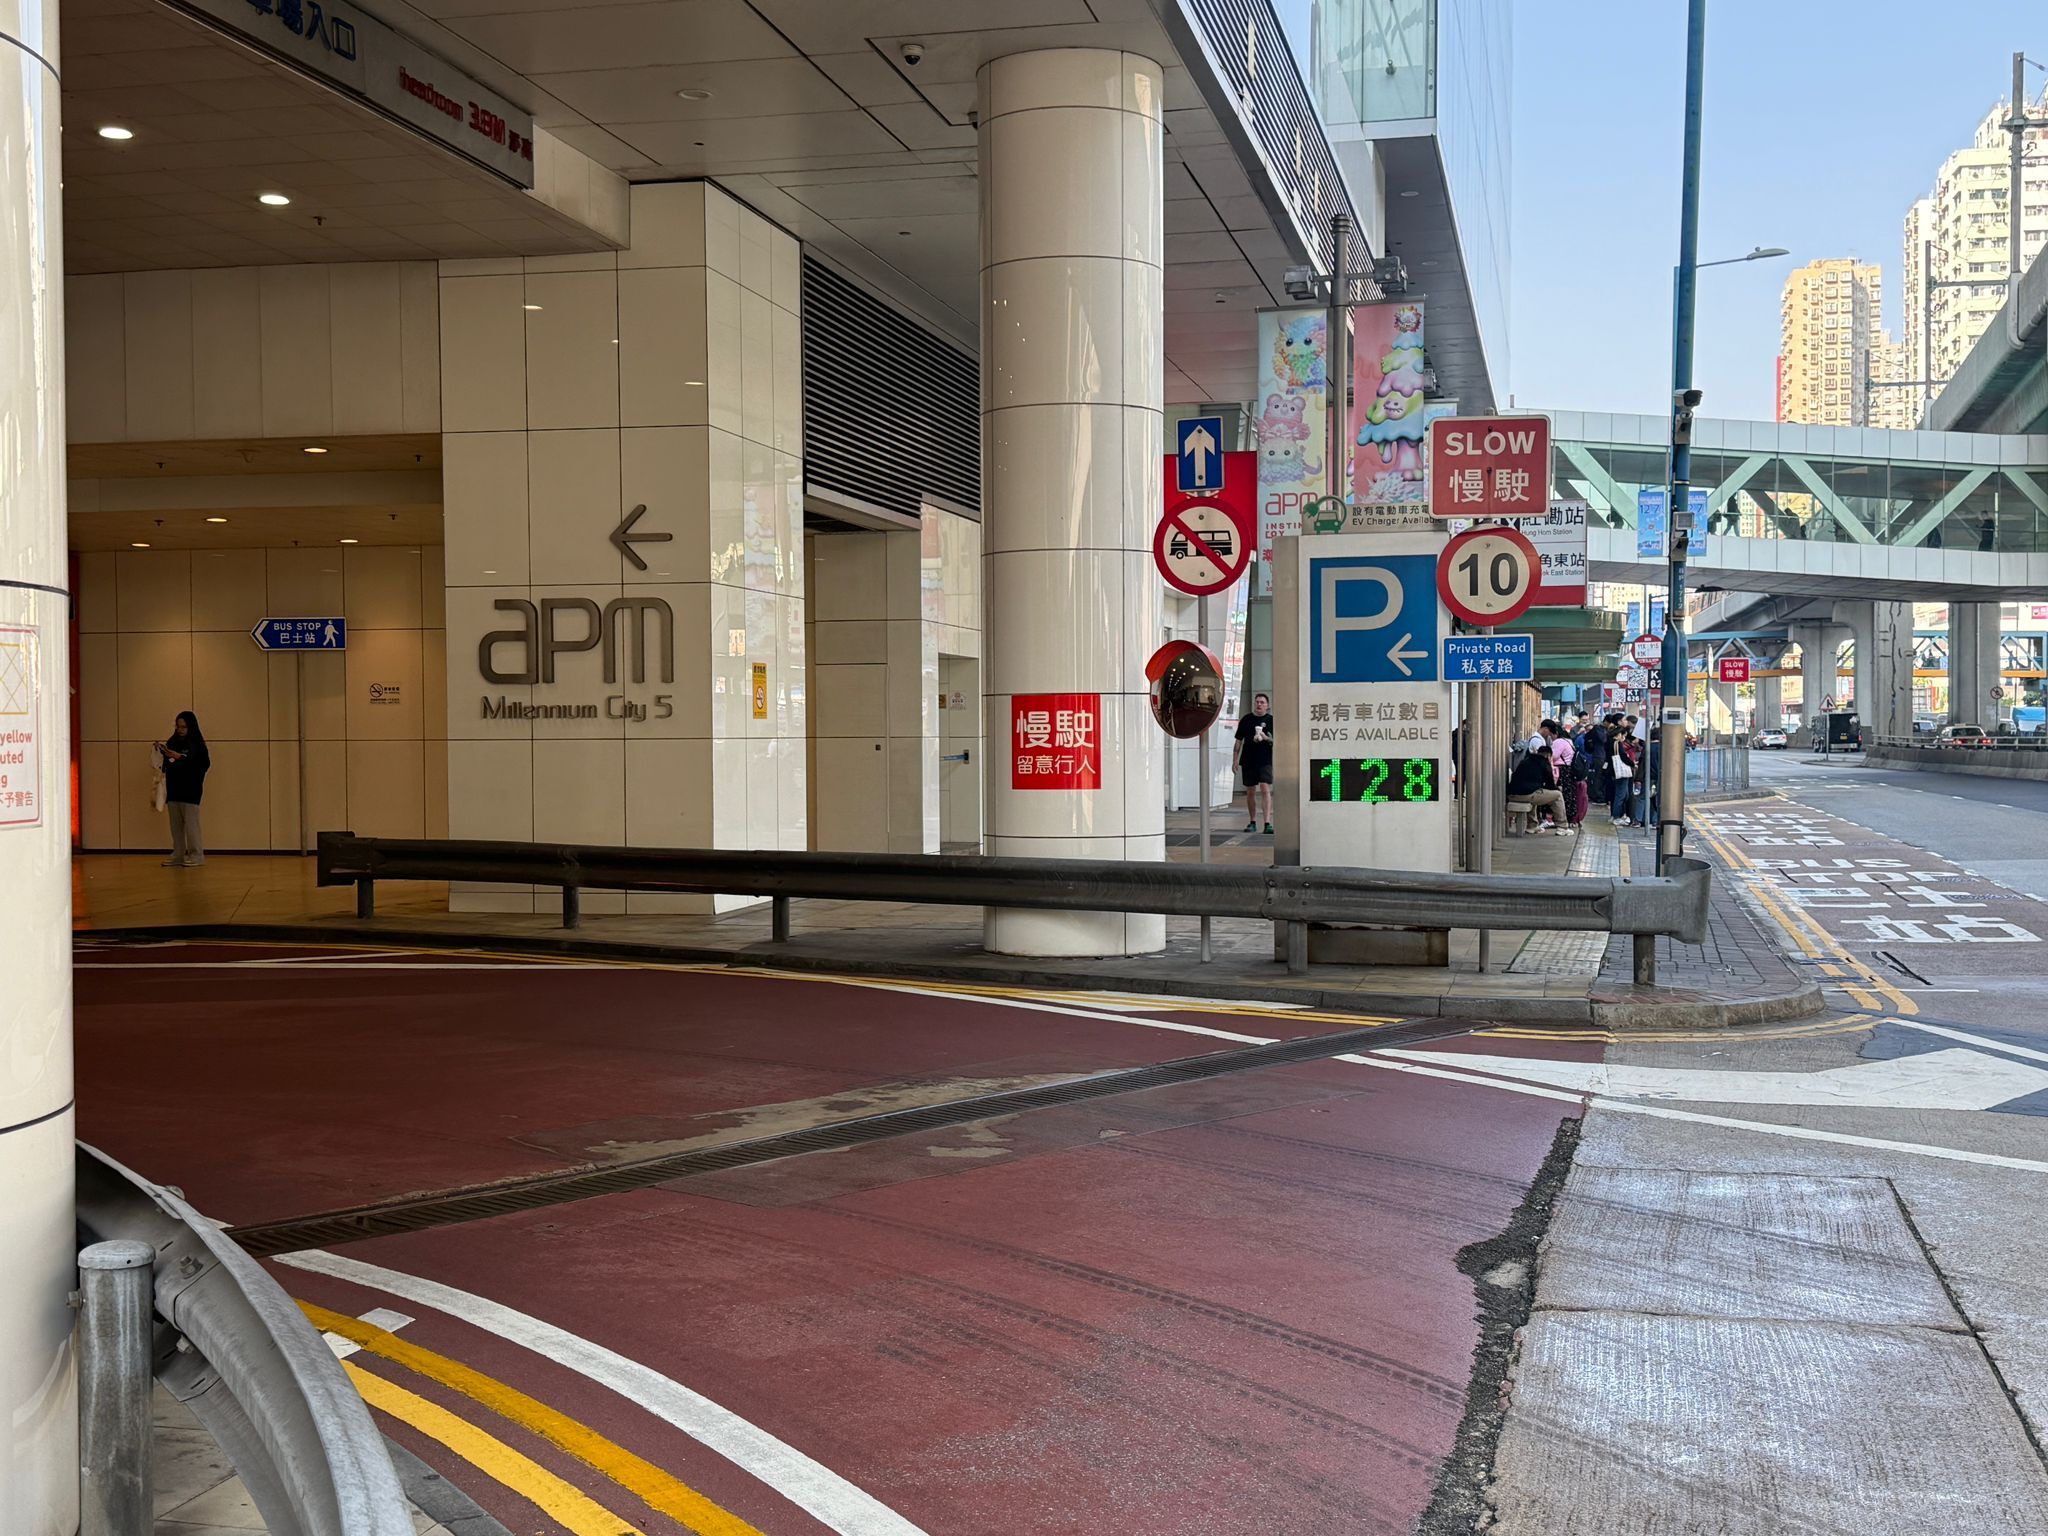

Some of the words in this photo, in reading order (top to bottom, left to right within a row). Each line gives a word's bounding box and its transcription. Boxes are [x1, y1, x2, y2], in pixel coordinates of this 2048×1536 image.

[1444, 431, 1536, 456] SLOW
[1449, 468, 1530, 503] 慢駛
[1352, 518, 1364, 526] EV
[1366, 516, 1399, 526] Charger
[1458, 552, 1519, 597] 10
[273, 622, 293, 631] BUS
[296, 622, 321, 631] STOP
[1321, 566, 1404, 674] P
[280, 632, 316, 644] 巴士站
[1449, 643, 1491, 654] Private
[1495, 642, 1526, 653] Road
[1461, 658, 1514, 674] 私家路
[480, 696, 598, 719] Millennium
[606, 695, 647, 722] City
[654, 694, 674, 719] 5
[1310, 702, 1439, 722] 現有車位數目
[0, 729, 33, 746] yellow
[1016, 709, 1094, 748] 慢駛
[1310, 728, 1348, 741] BAYS
[1355, 727, 1438, 741] AVAILABLE
[1017, 754, 1096, 774] 留意行人
[1320, 758, 1432, 802] 128
[1752, 858, 1912, 869] BUS
[1780, 886, 1988, 909] 巴士
